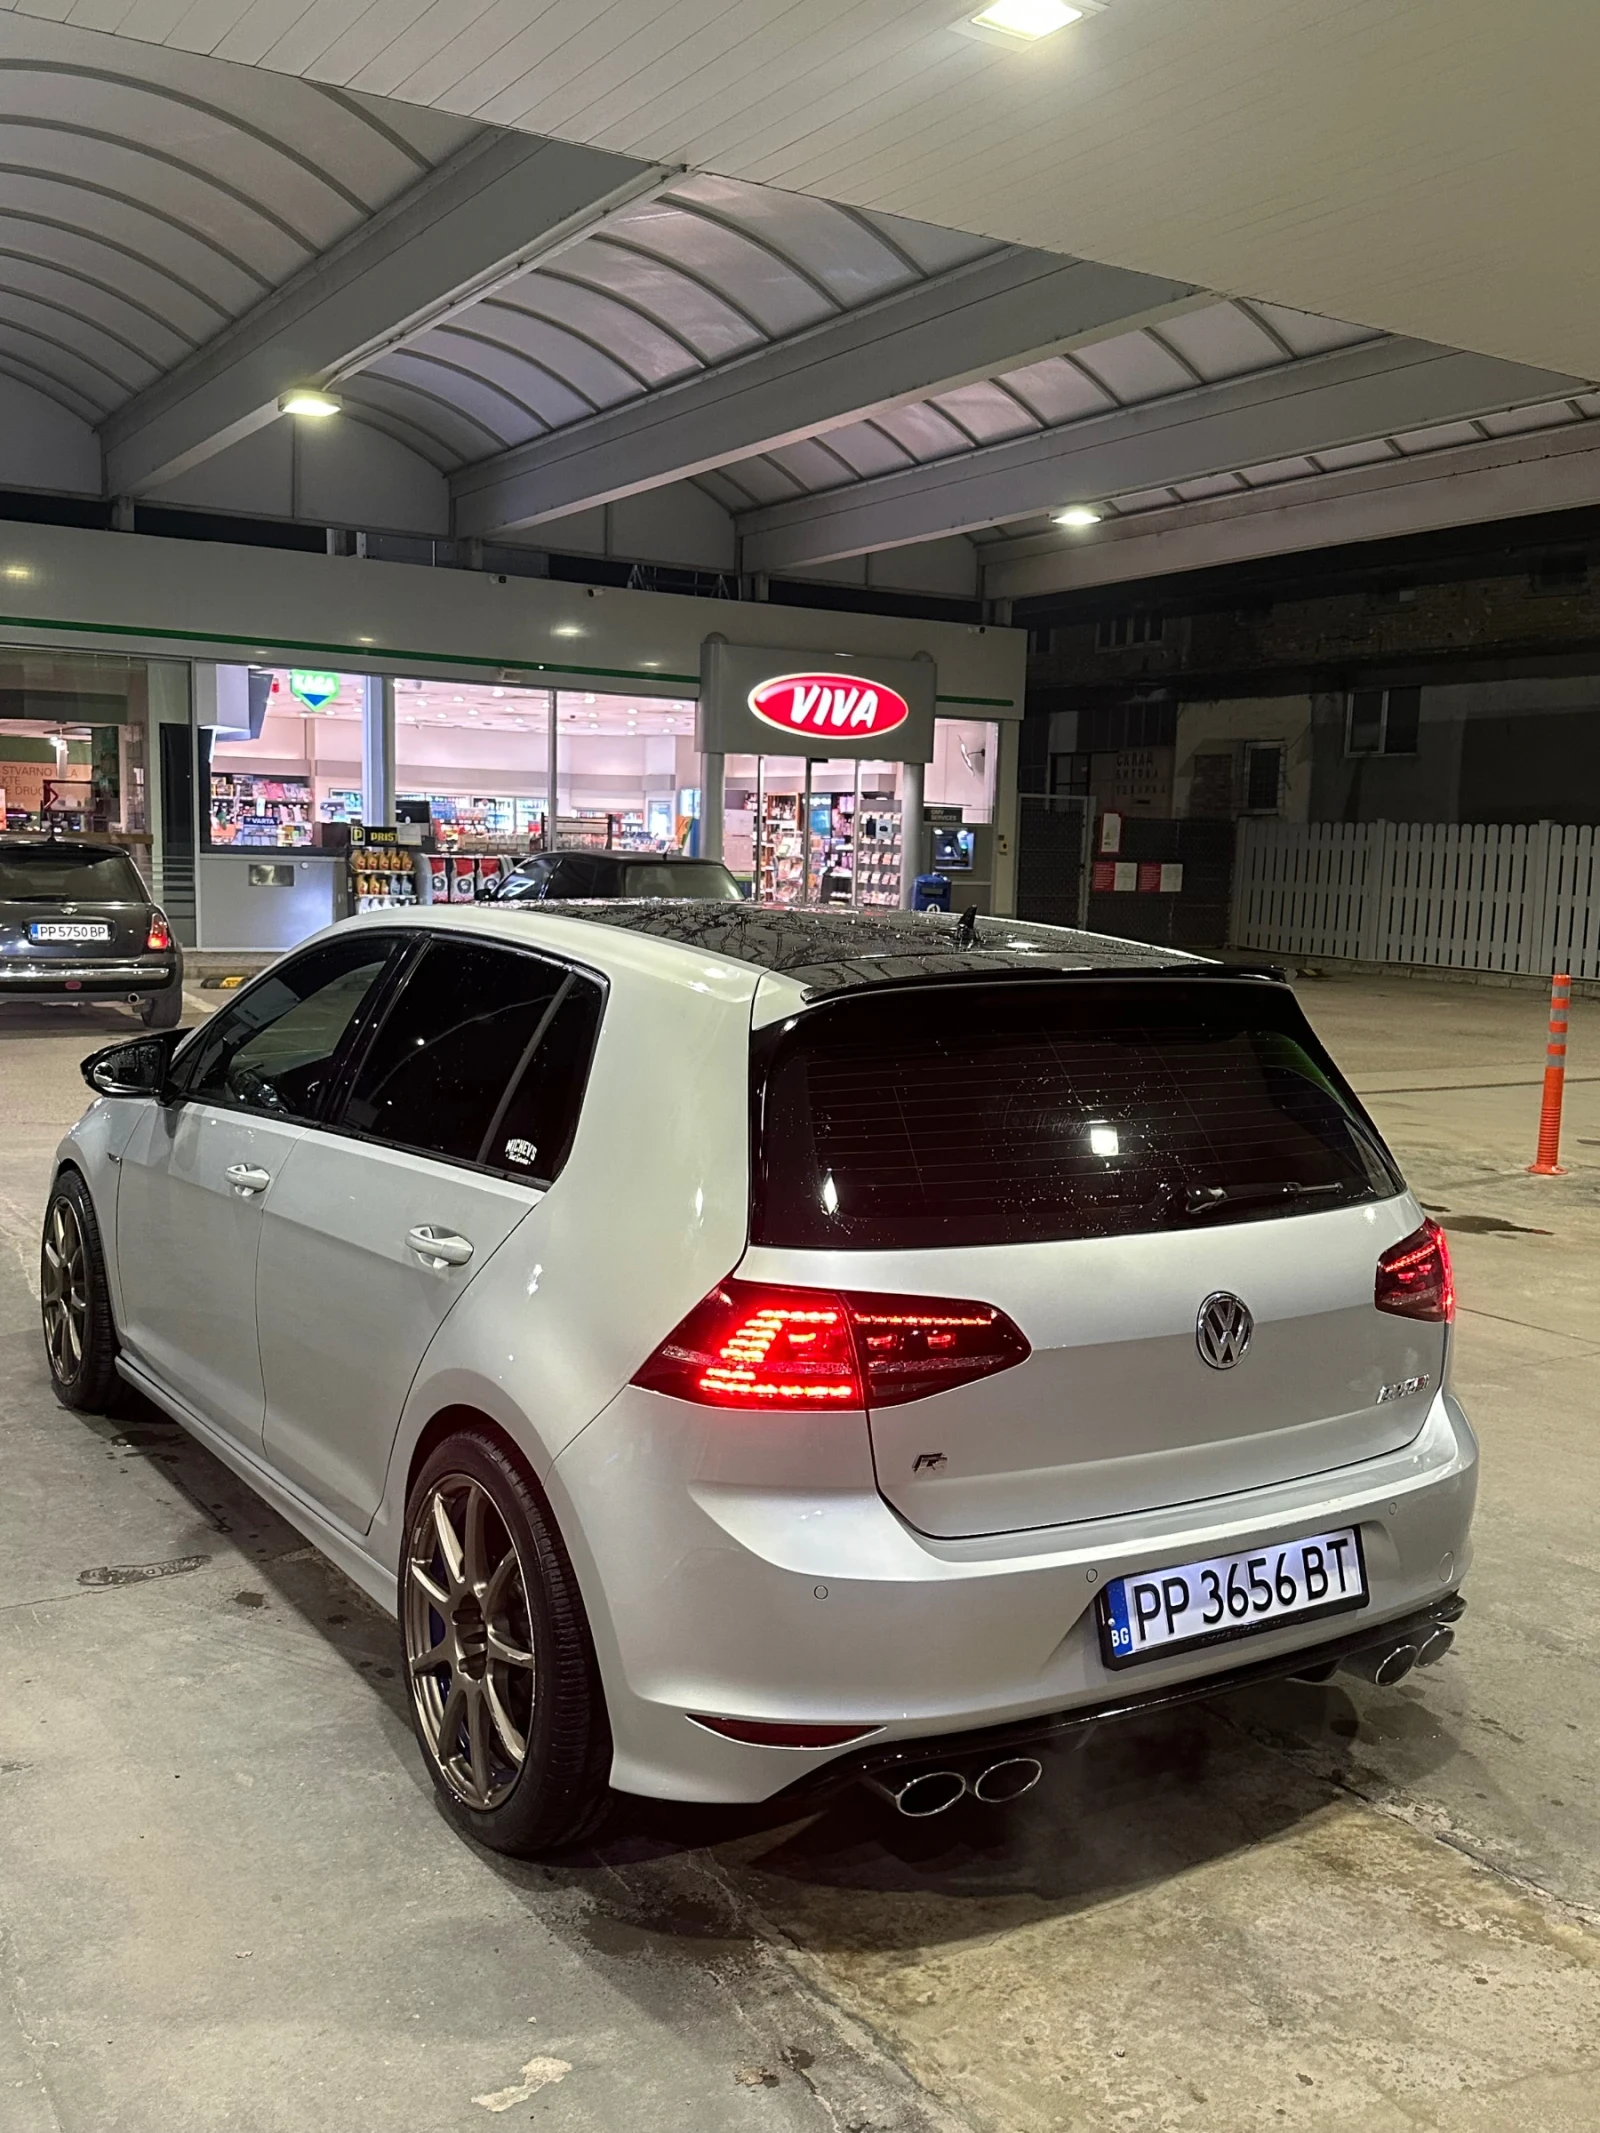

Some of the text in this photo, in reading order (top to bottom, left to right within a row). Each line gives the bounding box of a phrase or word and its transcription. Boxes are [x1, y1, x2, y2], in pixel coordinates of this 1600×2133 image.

[790, 684, 879, 729] VIVA
[2, 765, 53, 777] STVARNO
[251, 817, 275, 825] VARTA
[40, 926, 106, 938] PP 5750 BP
[1133, 1576, 1190, 1641] PP
[1200, 1552, 1297, 1624] 3656
[1301, 1538, 1349, 1601] BT
[1111, 1629, 1130, 1647] BG
